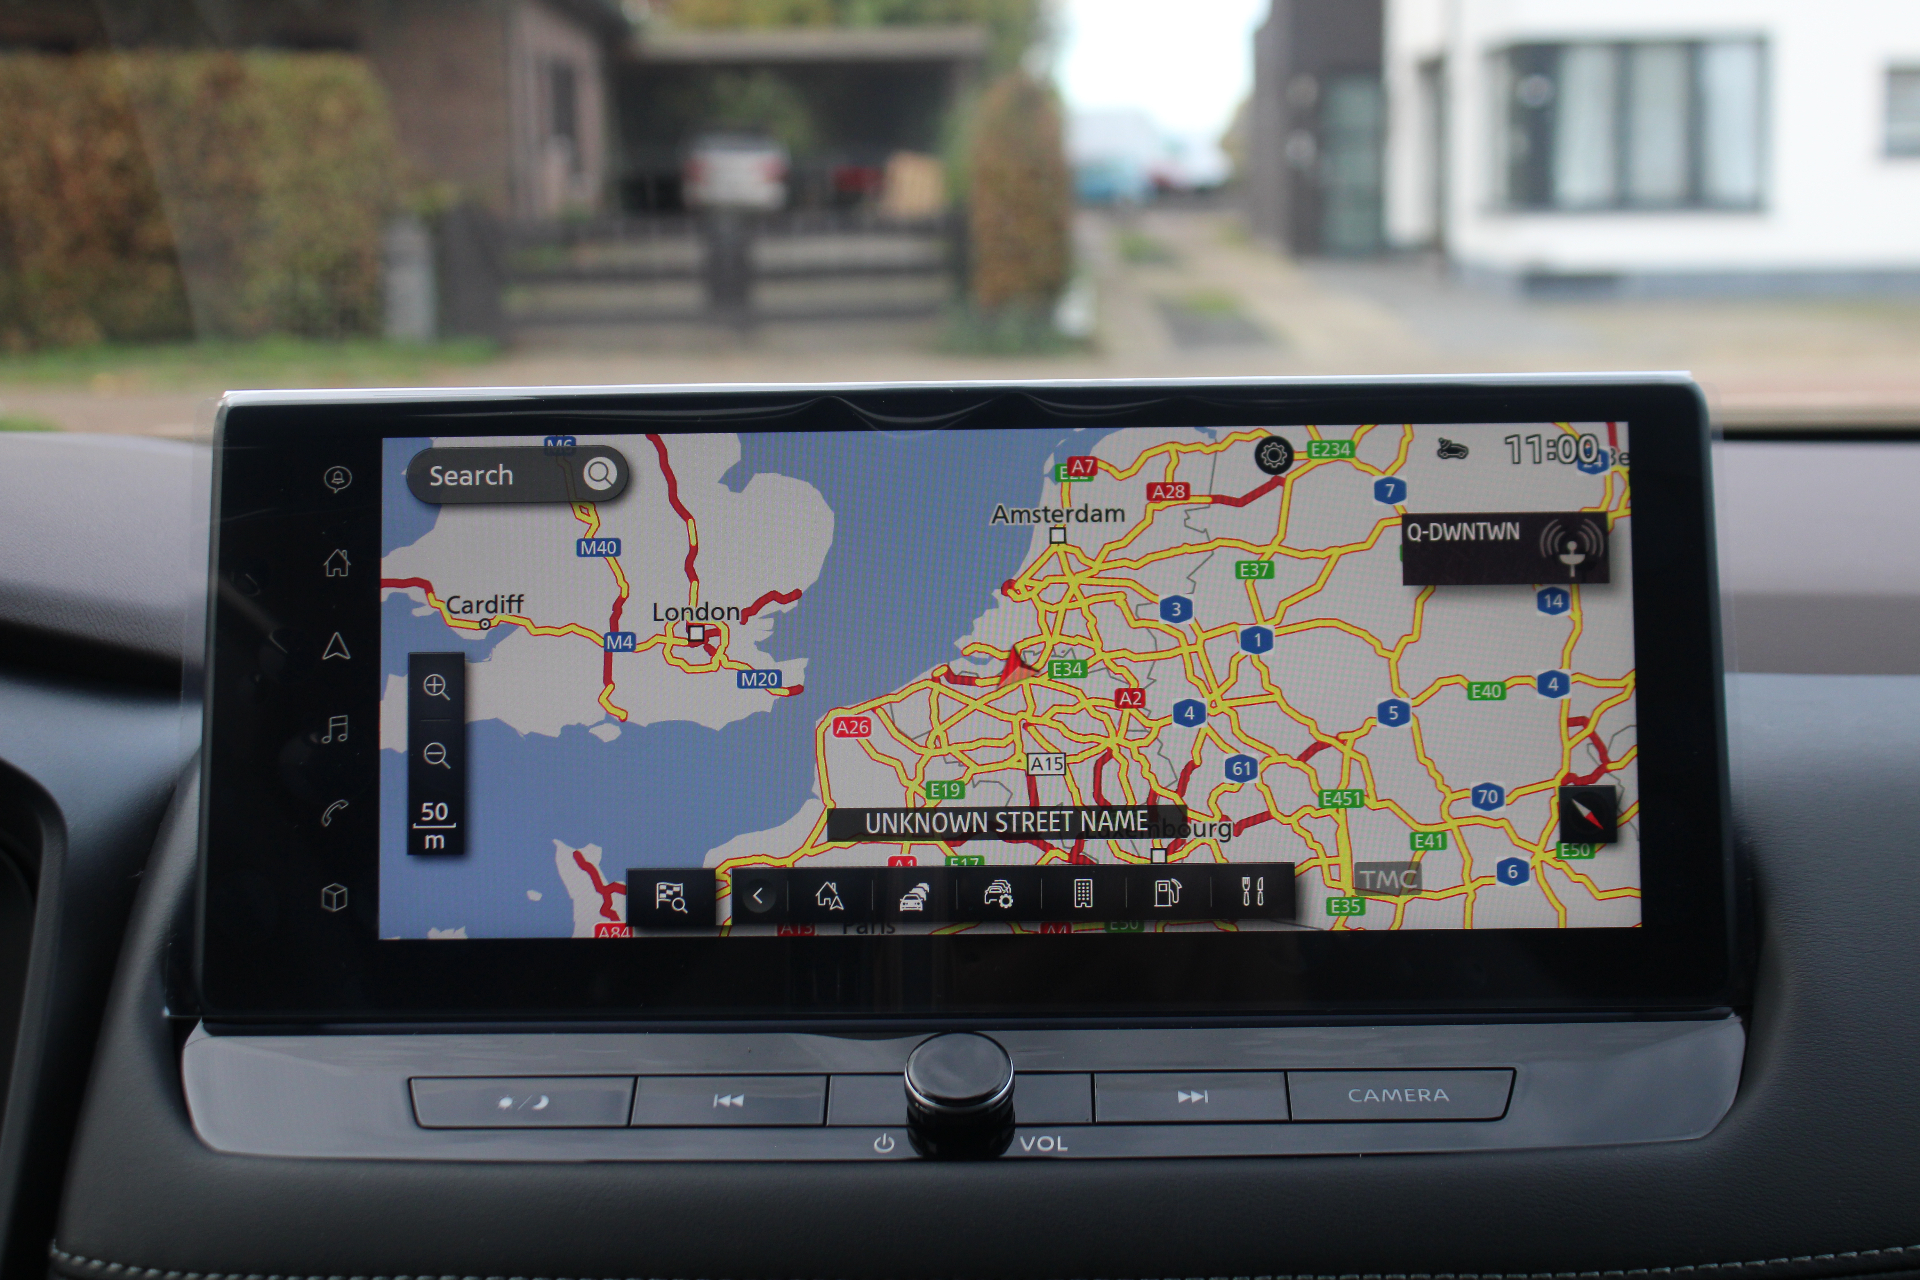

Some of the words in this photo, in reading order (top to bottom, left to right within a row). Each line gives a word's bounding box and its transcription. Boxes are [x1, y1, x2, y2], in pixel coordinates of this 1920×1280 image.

[1311, 442, 1350, 457] E234
[1504, 433, 1599, 465] 11:00
[1071, 459, 1094, 474] A7
[429, 463, 514, 487] Search
[1152, 485, 1186, 499] A28
[1385, 484, 1395, 498] 7
[991, 503, 1126, 524] Amsterdam
[1407, 522, 1520, 542] Q-DWNTWN
[580, 540, 617, 555] M40
[1240, 563, 1269, 577] E37
[446, 593, 525, 614] Cardiff
[1544, 593, 1563, 609] 14
[653, 602, 740, 622] London
[1171, 602, 1181, 616] 3
[607, 634, 633, 650] M4
[1053, 662, 1083, 677] E34
[741, 672, 778, 687] M20
[1548, 677, 1559, 691] 4
[1119, 691, 1142, 706] A2
[1472, 684, 1502, 698] E40
[1184, 706, 1195, 720] 4
[1389, 705, 1398, 720] 5
[836, 720, 869, 735] A26
[1030, 757, 1063, 771] A15
[1232, 761, 1251, 776] 61
[931, 782, 961, 797] E19
[1478, 789, 1498, 804] 70
[1323, 791, 1360, 806] E451
[421, 802, 448, 822] 50
[866, 812, 988, 834] UNKNOWN
[995, 810, 1074, 833] STREET
[1081, 809, 1149, 832] NAME
[424, 834, 445, 850] m
[1415, 833, 1442, 849] E41
[1561, 843, 1590, 857] E50
[1508, 863, 1518, 878] 6
[1359, 869, 1418, 889] TMC
[1331, 899, 1361, 914] E35
[1348, 1088, 1450, 1103] CAMERA
[1019, 1135, 1069, 1152] VOL
